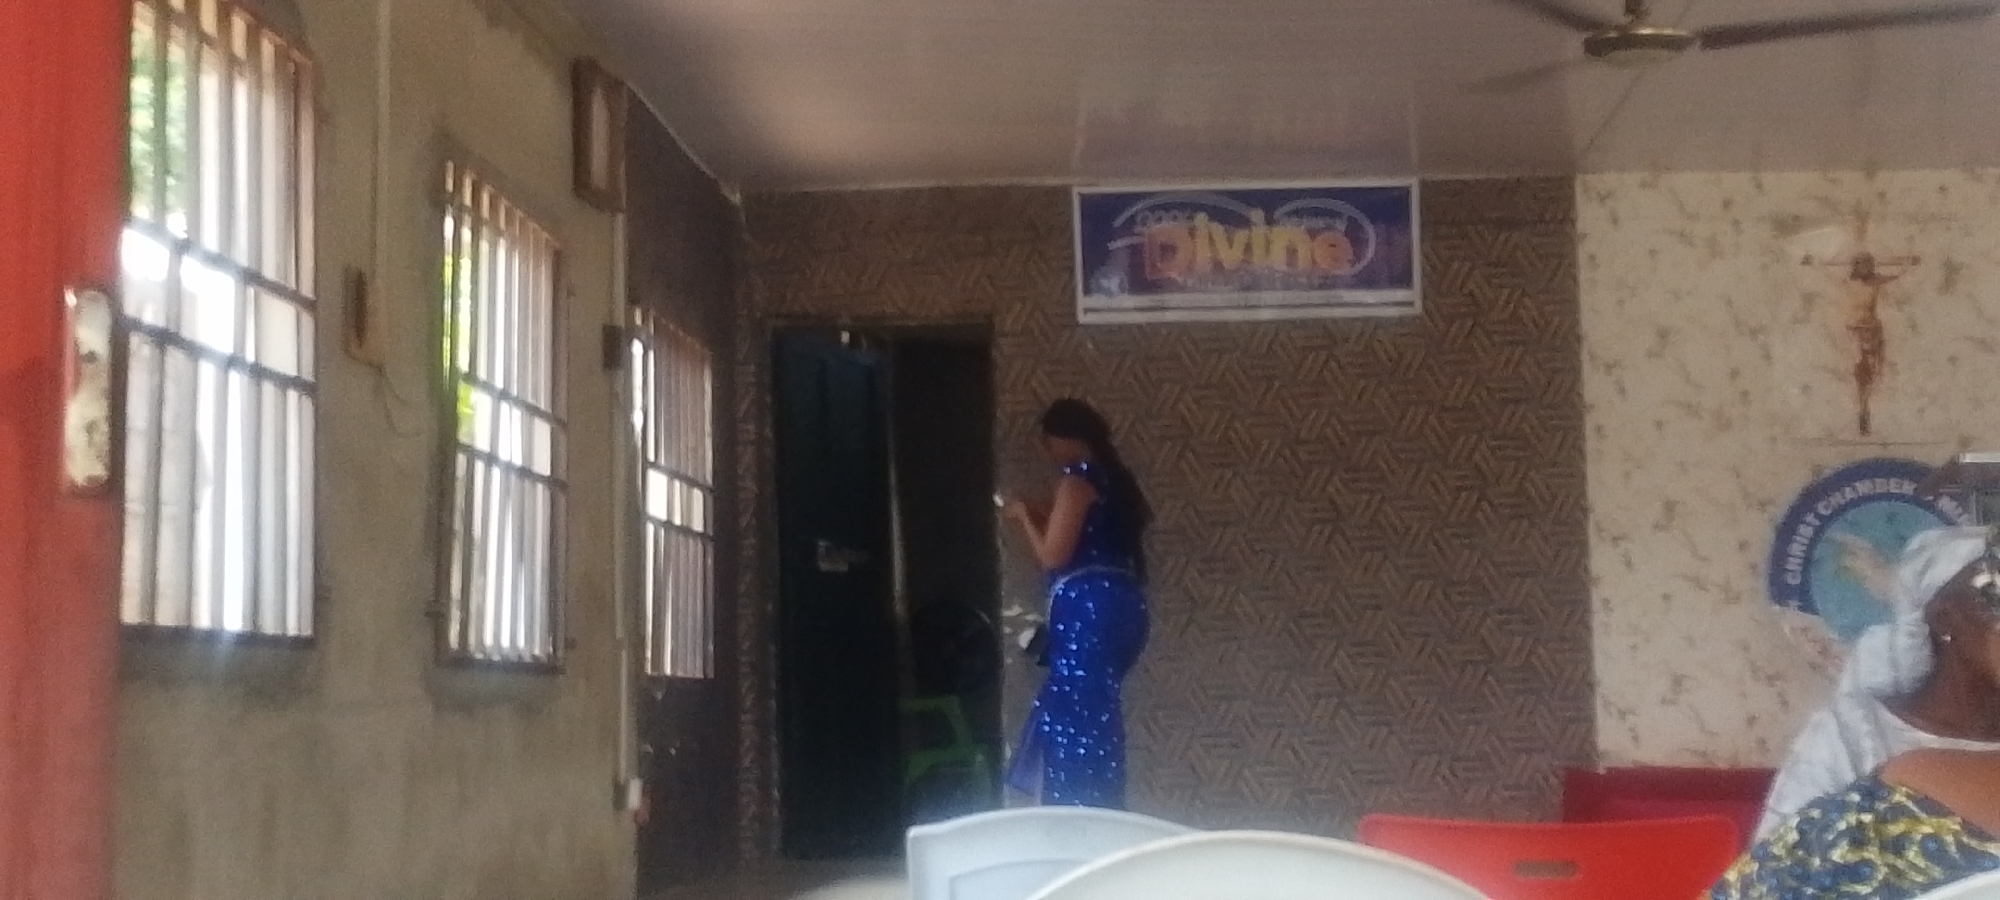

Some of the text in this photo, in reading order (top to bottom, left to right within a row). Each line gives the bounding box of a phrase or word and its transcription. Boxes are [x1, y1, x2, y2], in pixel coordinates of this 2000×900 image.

[1144, 208, 1354, 280] Divine
[1784, 511, 1821, 586] CHRIST
[1816, 477, 1935, 517] CHAMBER
